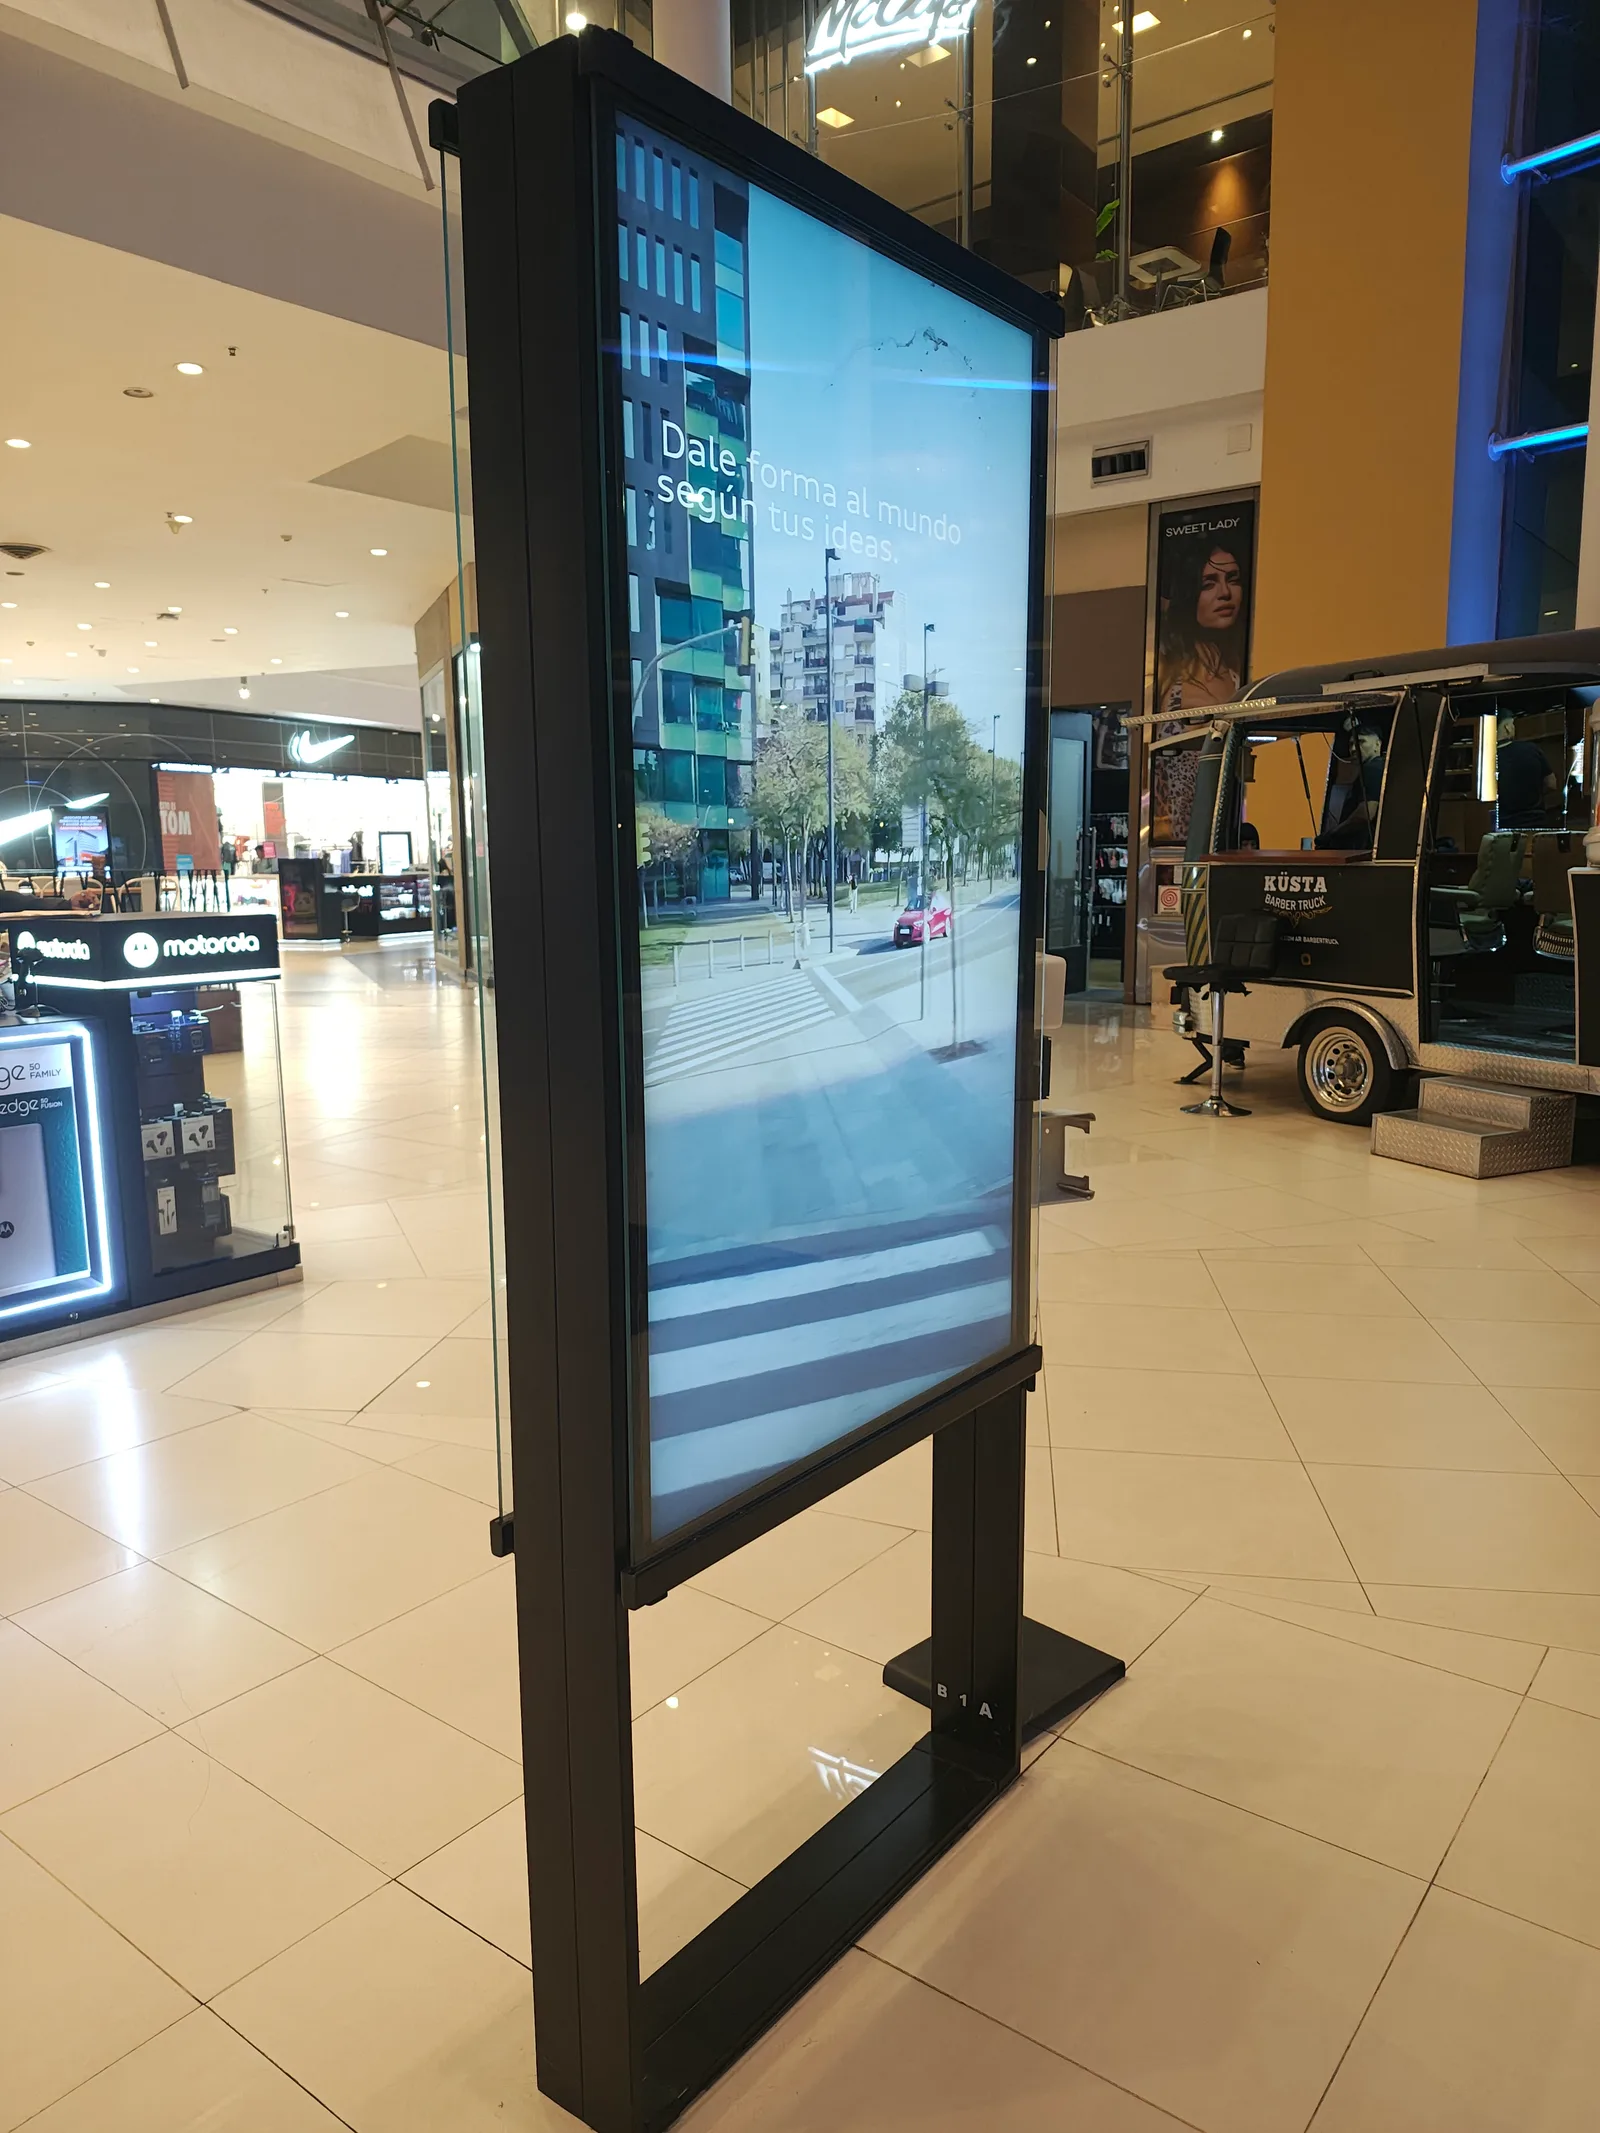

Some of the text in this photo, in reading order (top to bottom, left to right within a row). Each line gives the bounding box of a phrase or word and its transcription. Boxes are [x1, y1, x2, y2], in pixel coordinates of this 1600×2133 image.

[662, 420, 961, 545] Dale forma al mundo
[657, 473, 900, 565] según tus ideas.
[1165, 517, 1240, 537] SWEET LADY
[1263, 871, 1328, 892] KÜSTA
[1264, 893, 1327, 911] BARBER TRUCK
[162, 932, 260, 957] motorola
[29, 1062, 41, 1071] 50
[29, 1068, 61, 1079] FAMILY
[0, 1098, 39, 1117] edge
[40, 1100, 63, 1109] FUSION
[937, 1682, 993, 1720] B 1 A
